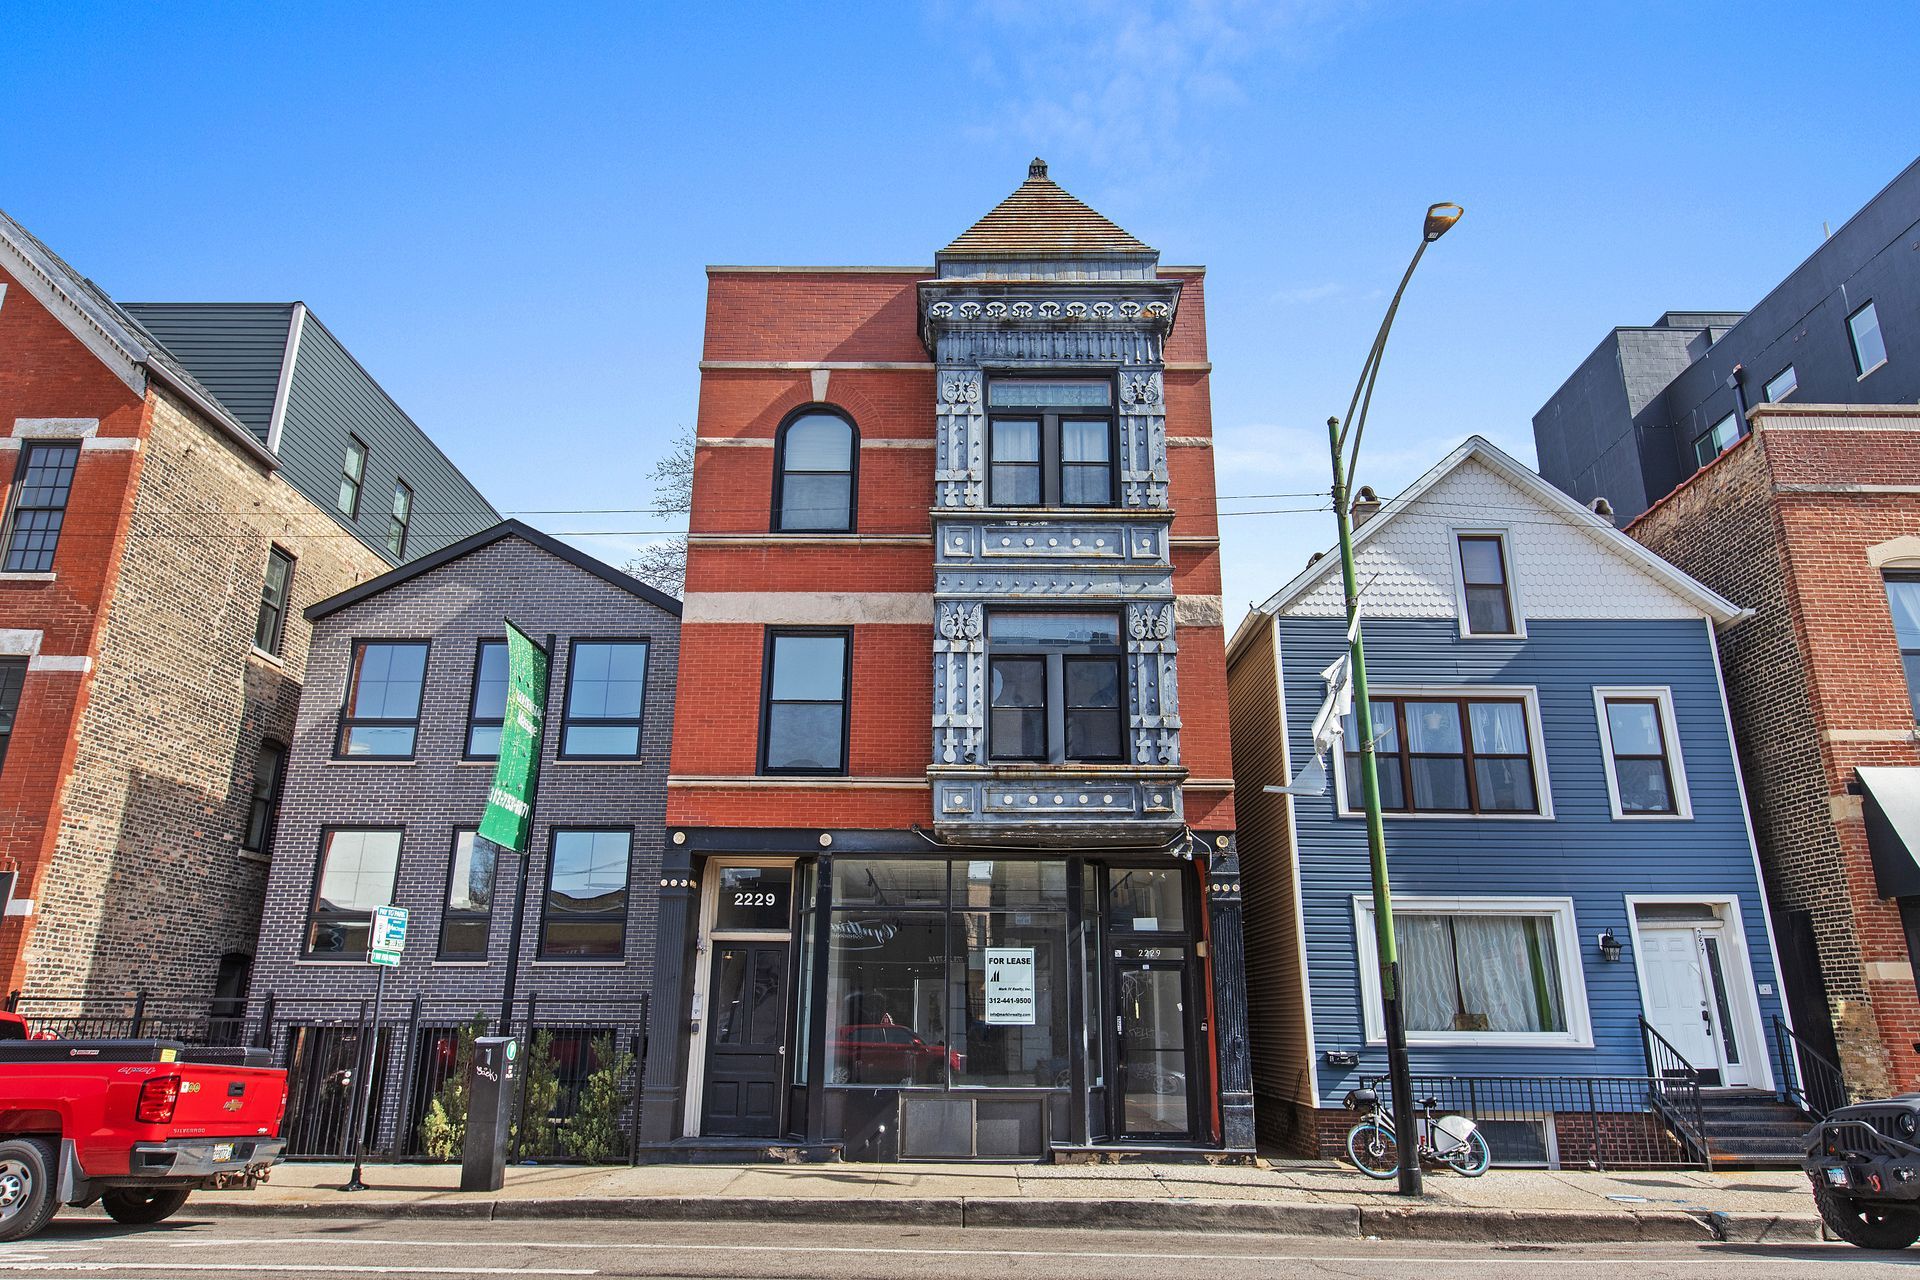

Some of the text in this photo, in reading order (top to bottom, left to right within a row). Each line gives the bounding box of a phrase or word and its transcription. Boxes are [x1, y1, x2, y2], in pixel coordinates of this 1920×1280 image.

[734, 893, 776, 906] 2229
[1138, 949, 1161, 957] 2229
[989, 957, 1031, 965] FOR LEASE
